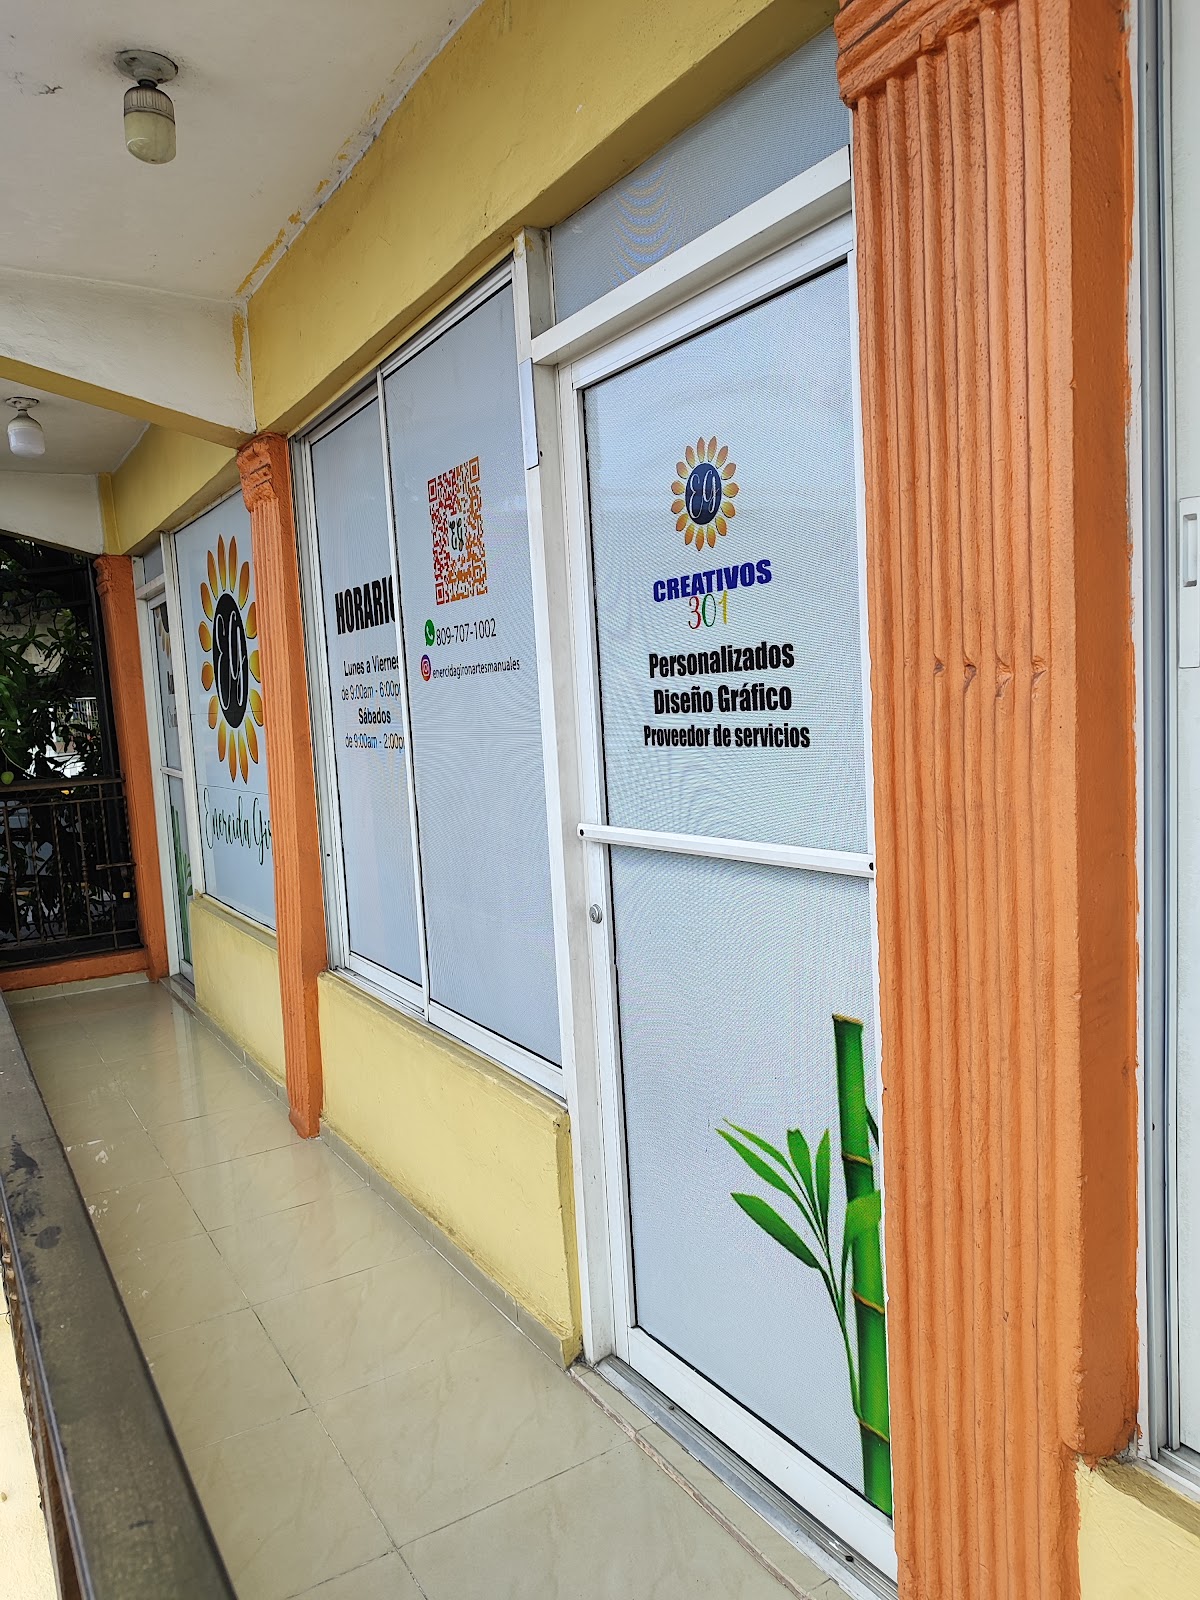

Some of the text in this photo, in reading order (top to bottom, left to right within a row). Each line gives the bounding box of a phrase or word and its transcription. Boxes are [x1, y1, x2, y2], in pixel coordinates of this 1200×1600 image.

[653, 559, 772, 603] CREATIVOS
[688, 590, 729, 630] 301
[436, 617, 497, 646] 809-707-1002
[343, 660, 365, 676] Lunes
[366, 660, 371, 673] a
[648, 641, 795, 678] Personalizados
[341, 685, 350, 701] de
[350, 684, 374, 700] 9:00am
[380, 680, 401, 700] 6:00p
[653, 682, 793, 714] Diseño Gráfico
[358, 706, 392, 724] Sábados
[345, 732, 353, 748] de
[353, 732, 378, 748] 9:00am
[383, 732, 405, 753] 2:00p
[643, 722, 811, 748] Proveedor de servicios
